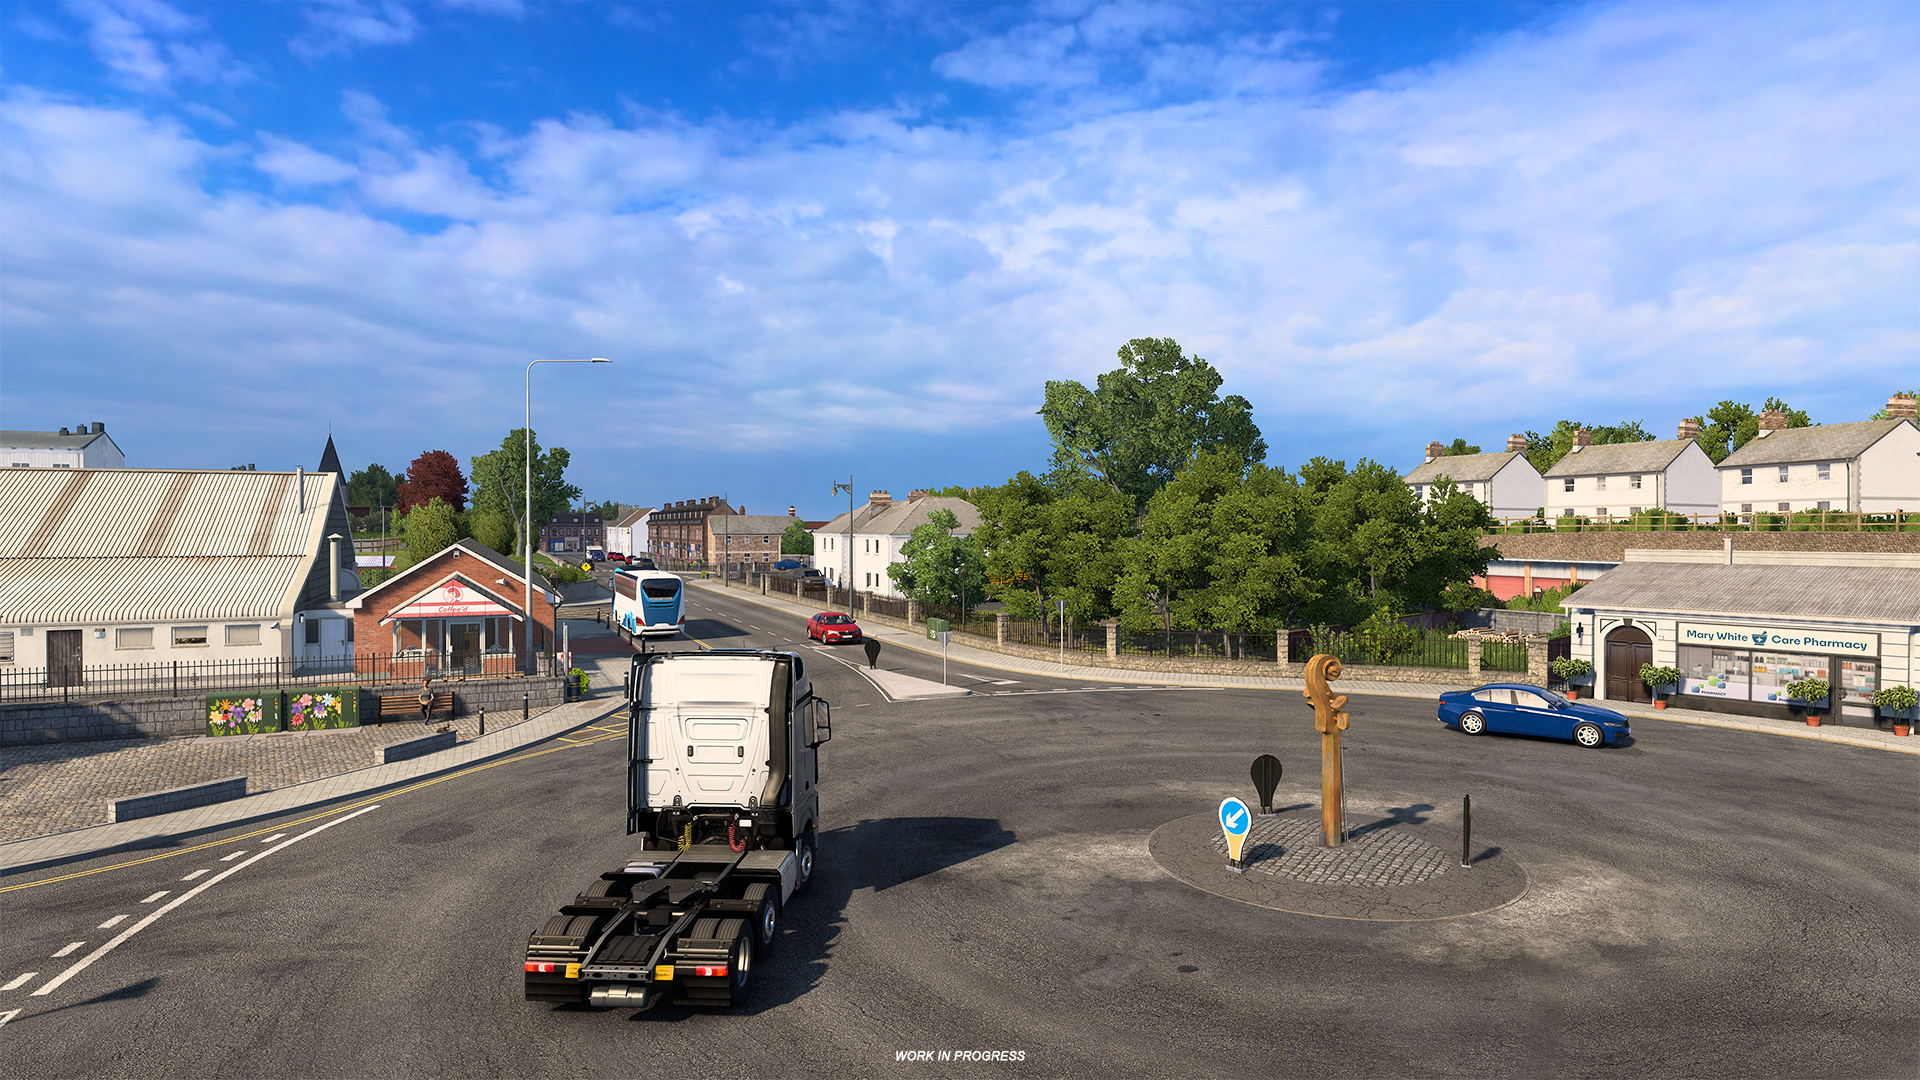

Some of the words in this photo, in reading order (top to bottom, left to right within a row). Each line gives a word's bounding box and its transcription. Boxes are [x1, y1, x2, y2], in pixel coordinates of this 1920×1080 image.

[1686, 630, 1714, 641] Mary
[1716, 631, 1749, 642] White
[1771, 635, 1801, 646] Care
[1803, 637, 1867, 651] Pharmacy
